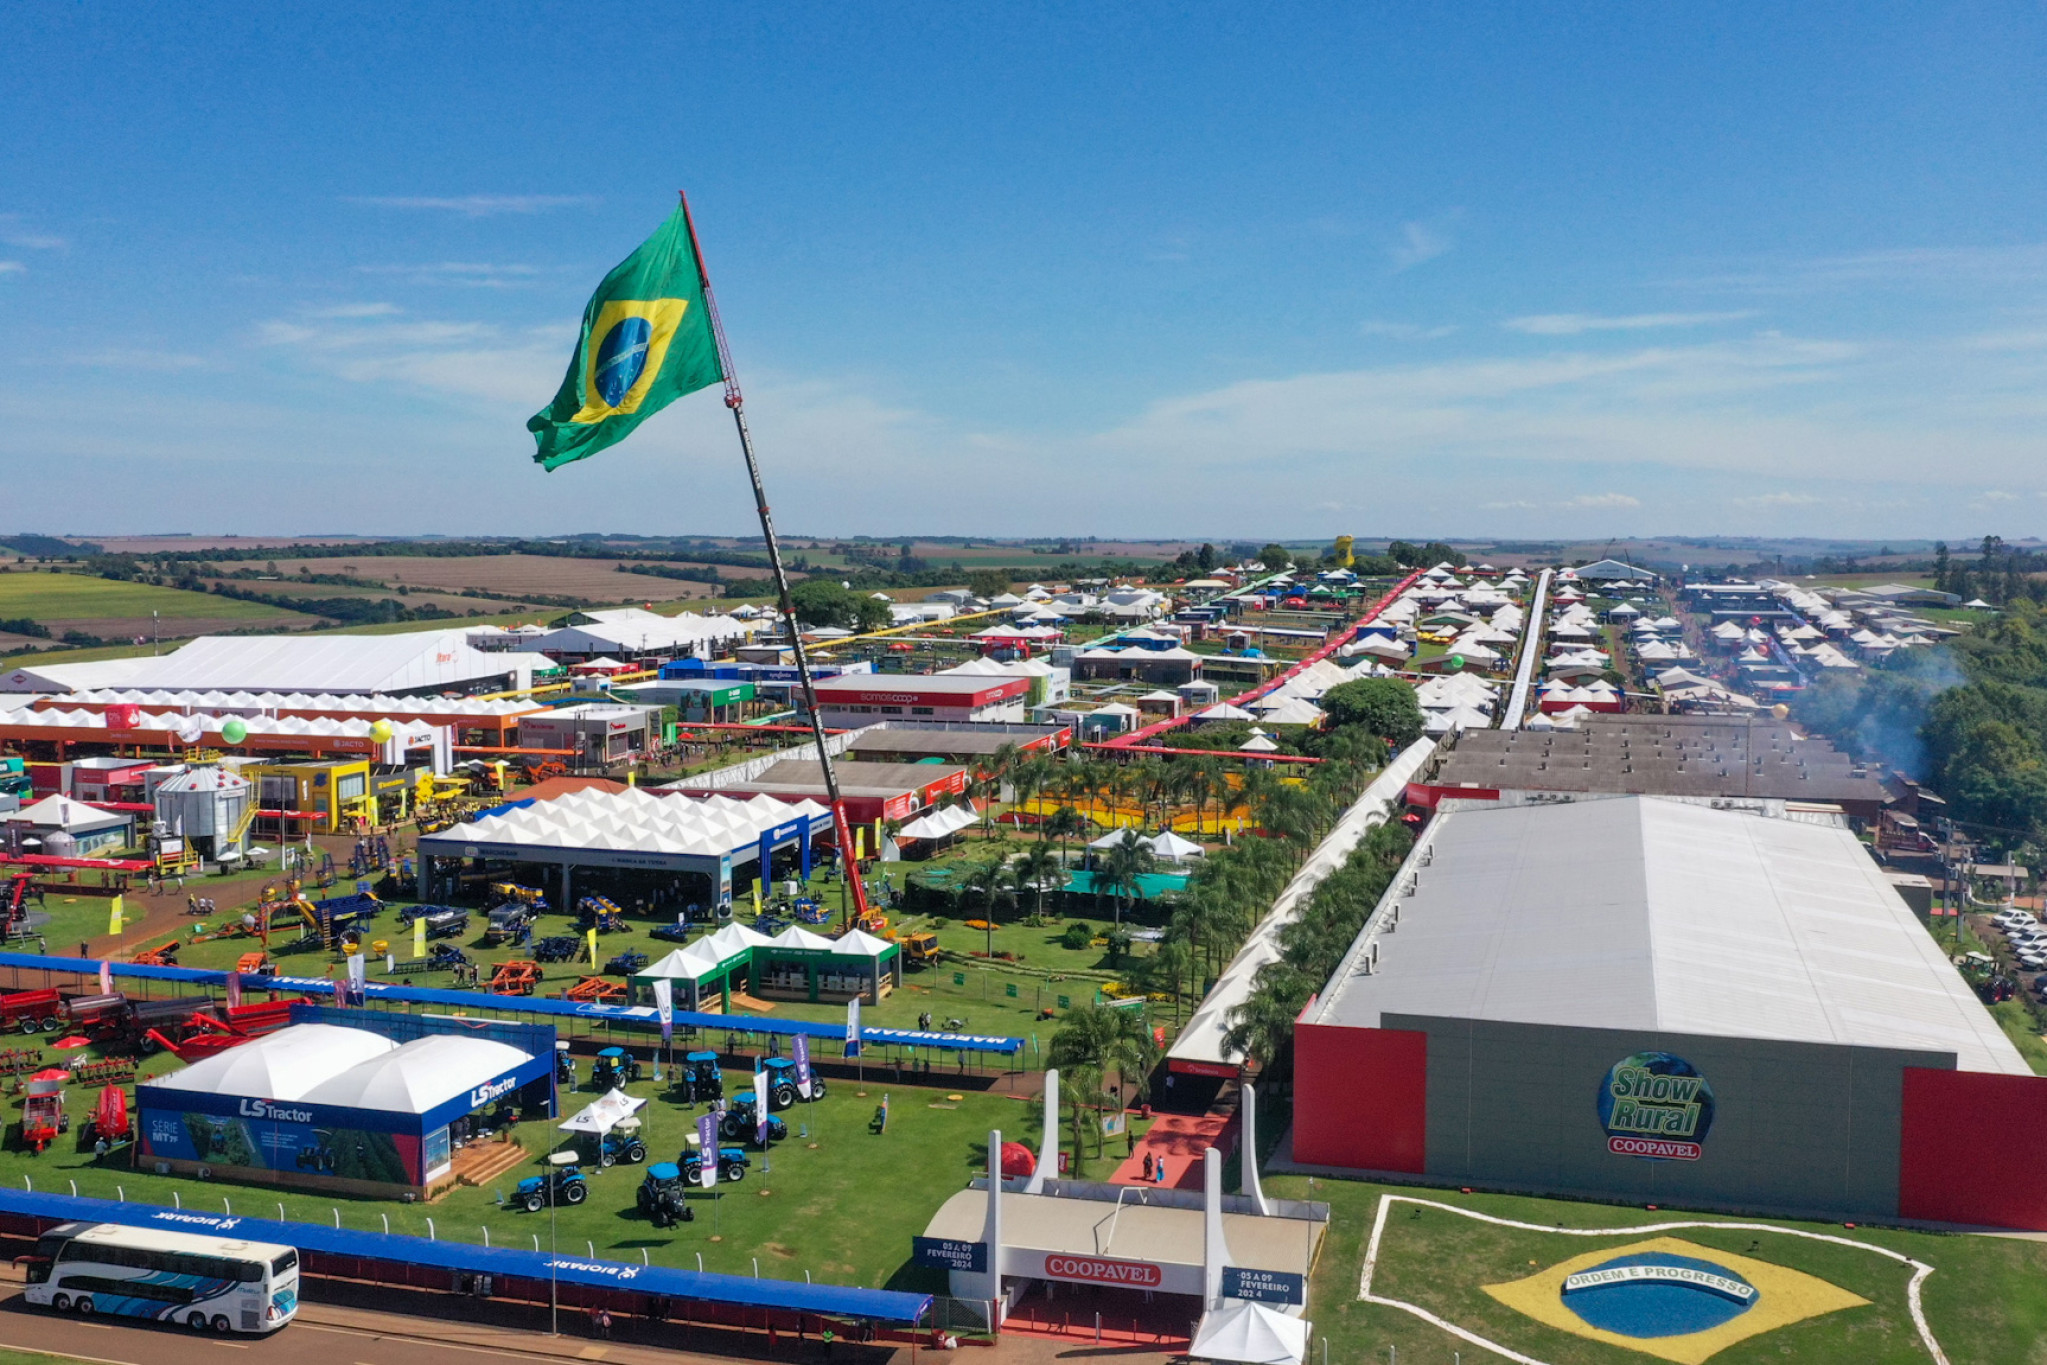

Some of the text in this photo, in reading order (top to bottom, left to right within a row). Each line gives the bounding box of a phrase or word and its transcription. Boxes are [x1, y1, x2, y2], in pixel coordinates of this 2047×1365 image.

[340, 740, 364, 748] JACTO
[414, 734, 431, 742] JACTO
[863, 1027, 1008, 1044] MARCHESAN
[471, 1076, 516, 1108] LS Tractor
[1612, 1067, 1701, 1102] Show
[239, 1099, 313, 1123] LS Tractor
[1611, 1099, 1699, 1134] Rural
[152, 1119, 178, 1133] SÉRIE
[576, 1115, 590, 1124] LS
[1612, 1140, 1697, 1157] COOPAVEL
[702, 1147, 713, 1166] LS
[152, 1211, 221, 1226] BIOPARK
[926, 1248, 972, 1260] FEVEREIRO
[942, 1242, 953, 1251] 05
[961, 1244, 972, 1252] 09
[545, 1260, 619, 1275] BIOPARK
[952, 1260, 972, 1269] 2024
[1050, 1258, 1156, 1283] COOPAVEL
[1240, 1271, 1251, 1280] 05
[1261, 1274, 1273, 1282] 09
[1568, 1267, 1751, 1297] ORDEM E PROGRESSO
[1240, 1280, 1290, 1293] FEVEREIRO
